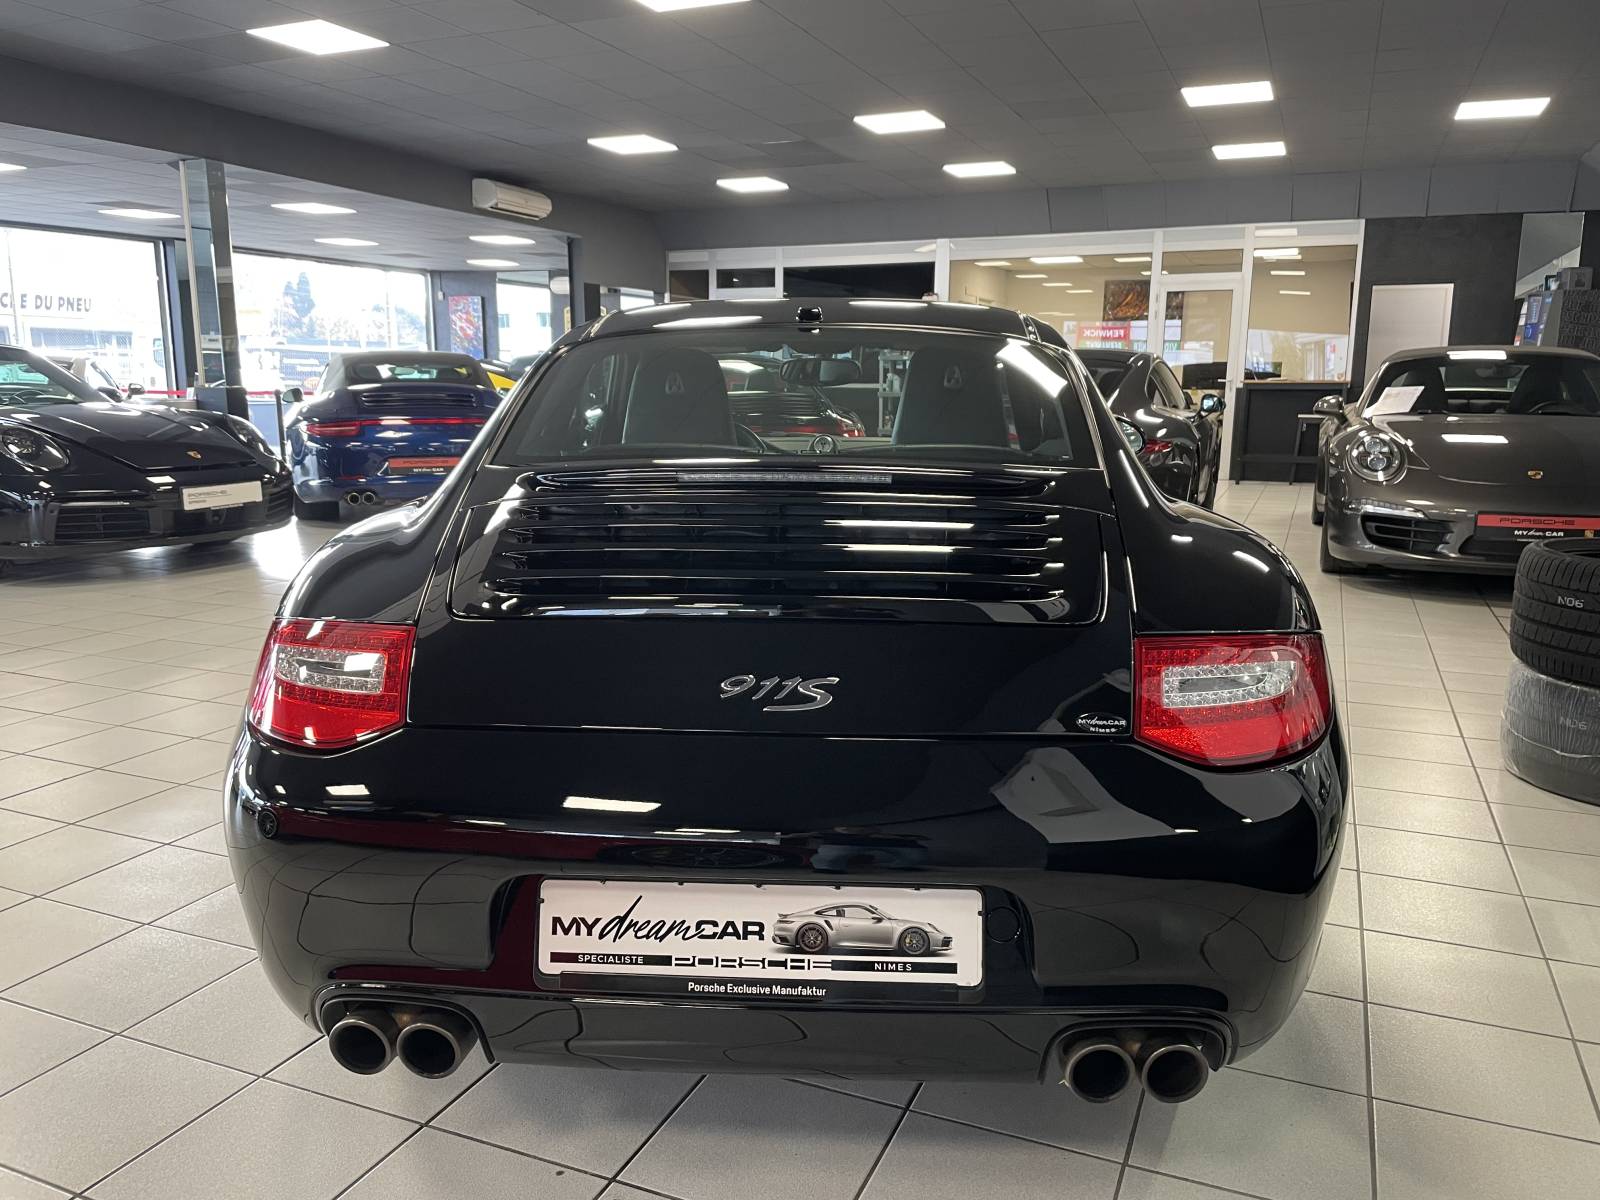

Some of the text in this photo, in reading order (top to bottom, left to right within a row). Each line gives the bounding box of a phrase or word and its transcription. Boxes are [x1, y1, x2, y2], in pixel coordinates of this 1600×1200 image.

[35, 294, 53, 310] DU
[58, 296, 92, 312] PNEU
[1499, 517, 1576, 526] PORSCHE
[577, 953, 913, 972] SPECIALISTE PORSCHE NIMES
[687, 981, 827, 997] Porsche Exclusive Manufaktur
